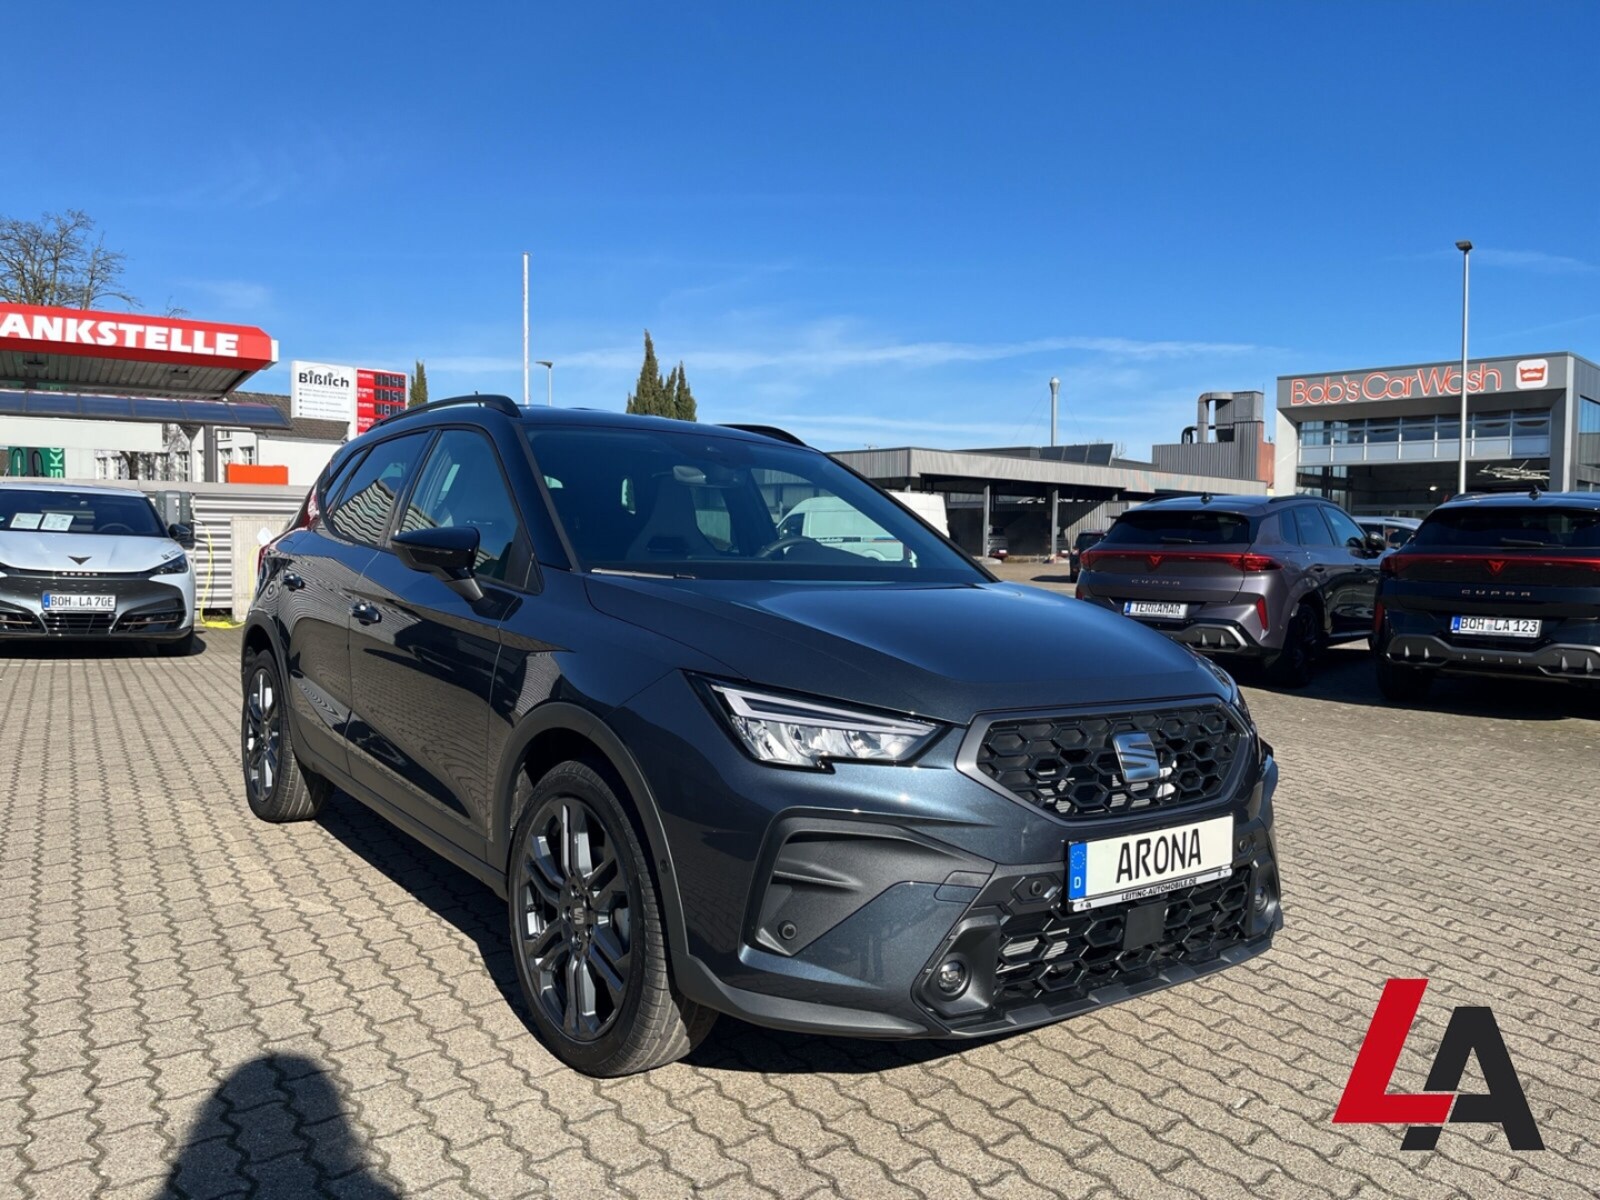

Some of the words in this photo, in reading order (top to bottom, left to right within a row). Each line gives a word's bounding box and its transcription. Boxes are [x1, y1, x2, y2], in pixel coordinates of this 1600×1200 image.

[0, 313, 239, 357] ANKSTELLE
[298, 370, 349, 388] Bißlich
[1290, 376, 1360, 406] Bob's
[1362, 371, 1417, 400] Car
[1417, 364, 1502, 396] Wash
[51, 596, 72, 607] BOH
[79, 596, 92, 607] LA
[1460, 617, 1485, 630] BOH
[1494, 619, 1511, 631] LA
[1512, 620, 1538, 633] 123
[1115, 828, 1202, 884] ARONA
